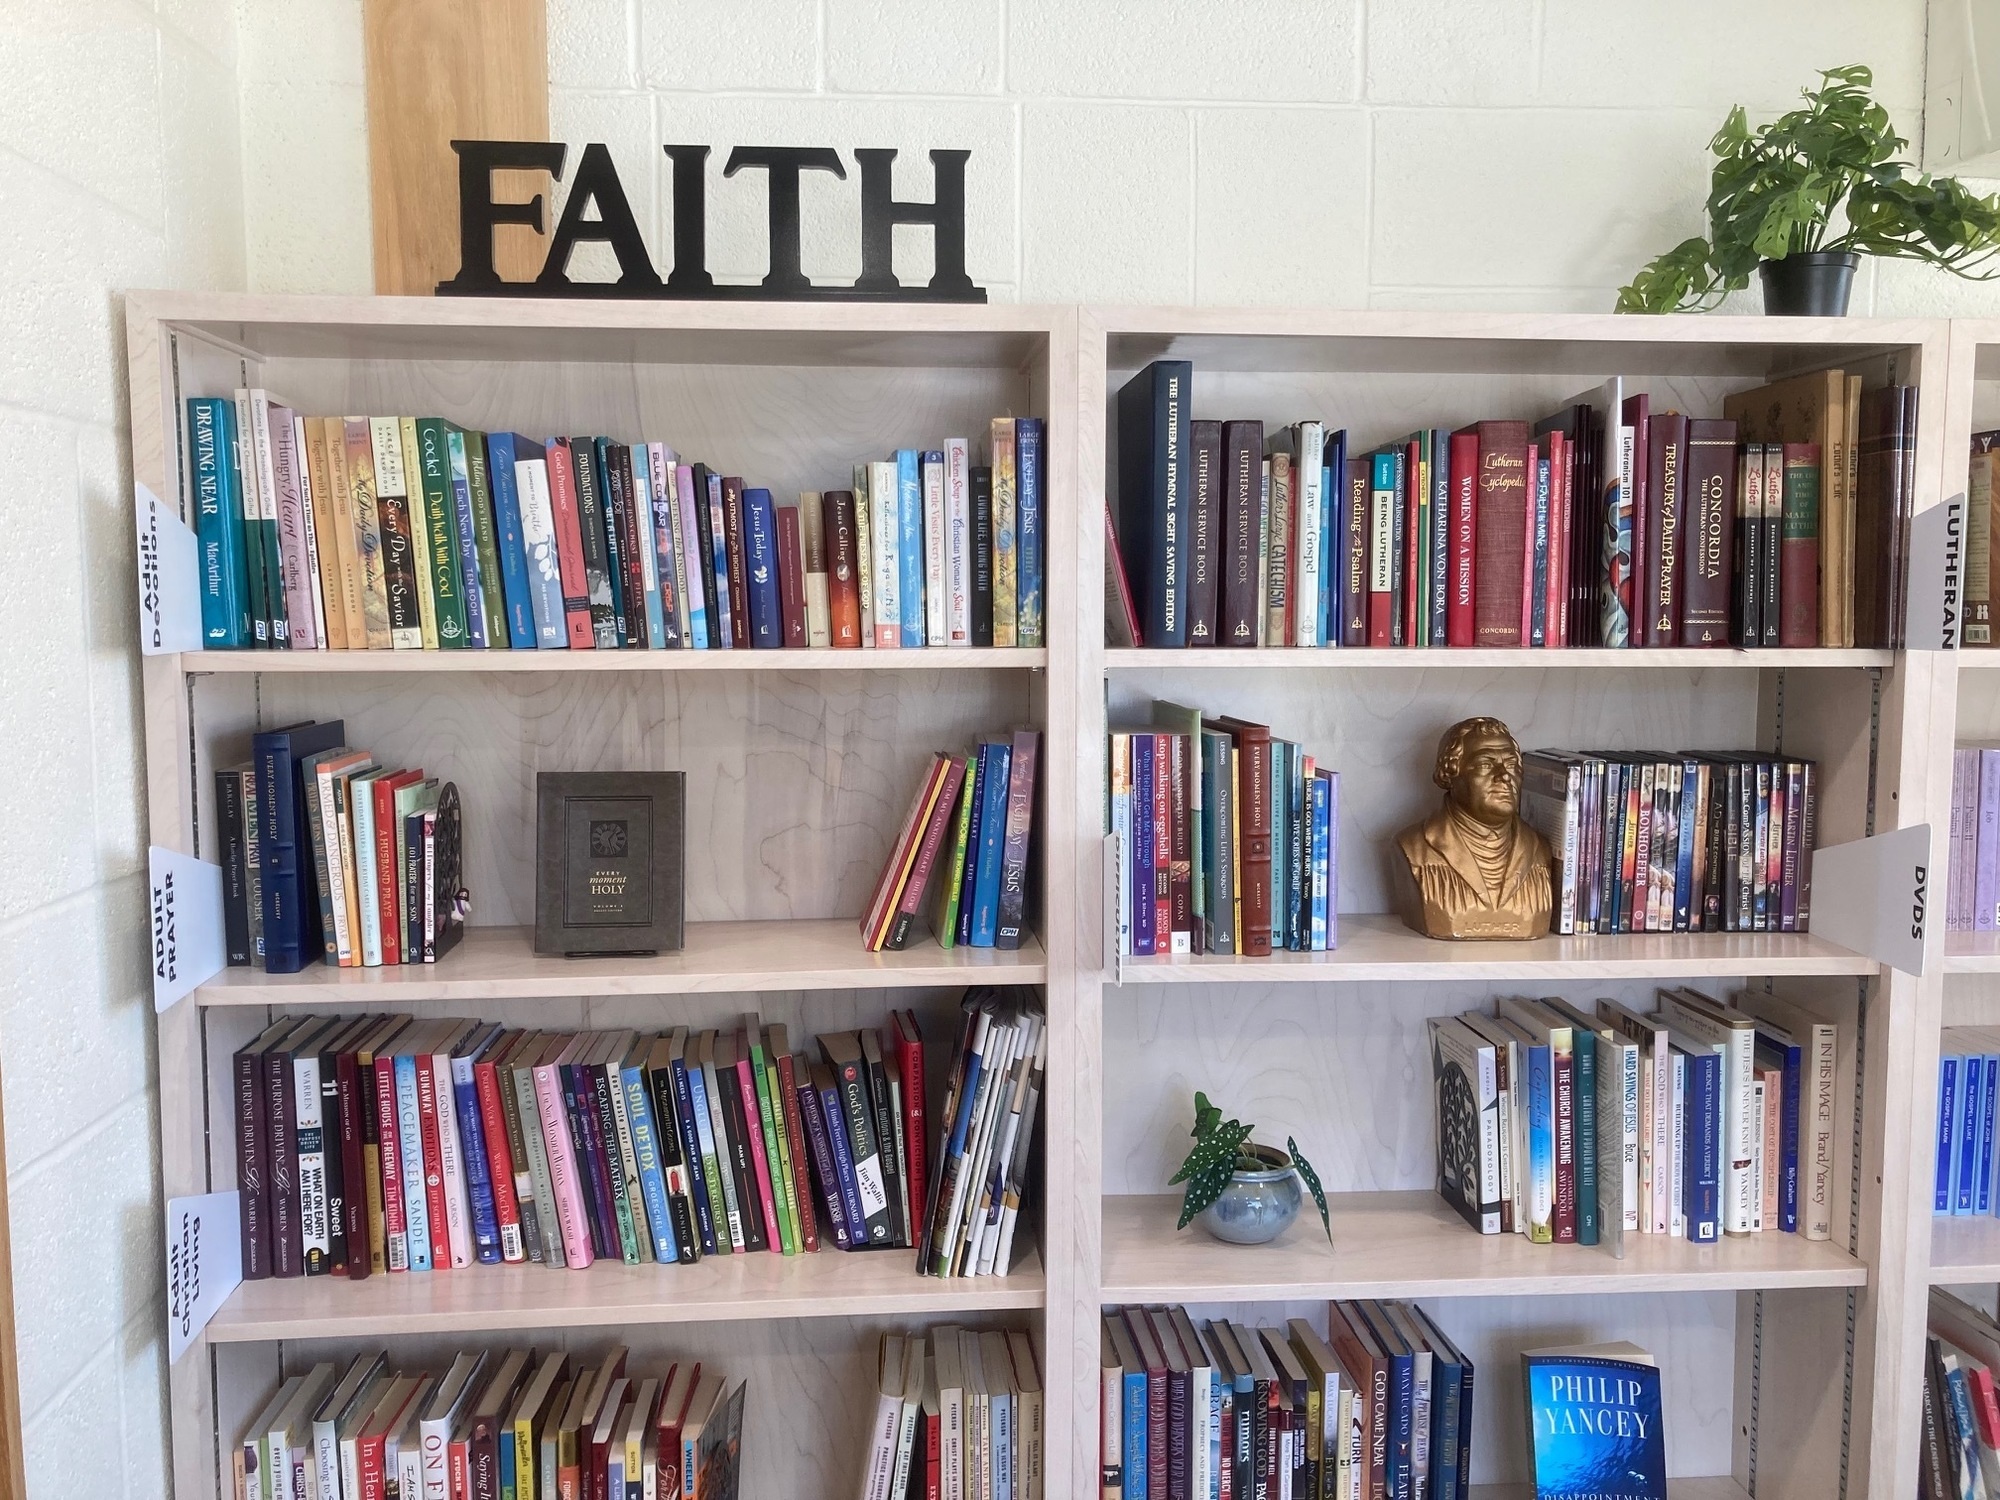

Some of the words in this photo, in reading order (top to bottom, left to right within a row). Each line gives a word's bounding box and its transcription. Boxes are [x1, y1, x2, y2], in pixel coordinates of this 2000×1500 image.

[449, 139, 973, 290] FAITH
[1169, 377, 1178, 398] THE
[196, 405, 216, 470] DRAWING
[1167, 402, 1177, 460] LUTHERAN
[1485, 453, 1523, 470] Lutheran
[1621, 436, 1632, 483] Lutheranism
[1663, 443, 1676, 508] TREASURY
[578, 453, 594, 514] FOUNDATIONS
[1166, 462, 1177, 510] HYMNAL
[1198, 449, 1208, 506] LUTHERAN
[1239, 449, 1249, 506] LUTHERAN
[1621, 486, 1631, 500] 101
[201, 475, 217, 514] NEAR
[456, 488, 467, 511] Each
[1306, 484, 1317, 510] Law
[1460, 476, 1472, 522] WOMEN
[459, 514, 469, 536] New
[1166, 513, 1176, 543] SIGHT
[1306, 514, 1314, 528] and
[1379, 496, 1388, 528] BEING
[1437, 480, 1447, 550] KATHARINA
[1661, 508, 1673, 517] of
[1699, 494, 1708, 529] LUTHERAN
[1707, 475, 1723, 579] CONCORDIA
[1197, 509, 1207, 551] SERVICE
[1238, 509, 1248, 551] SERVICE
[1460, 525, 1470, 543] ON
[1661, 517, 1676, 555] DAILY
[460, 538, 472, 558] Day
[1304, 531, 1317, 574] Gospel
[1378, 531, 1387, 587] LUTHERAN
[1460, 546, 1470, 554] A
[1698, 530, 1707, 575] CONFESSIONS
[141, 532, 152, 613] Adult
[148, 500, 161, 648] Devotions
[206, 541, 221, 596] MacArthur
[465, 567, 474, 585] TEN
[1165, 546, 1175, 586] SAVING
[1196, 554, 1206, 585] BOOK
[1237, 554, 1247, 585] BOOK
[1436, 552, 1446, 579] VON
[1459, 558, 1469, 606] MISSION
[1660, 554, 1673, 606] PRAYER
[1942, 503, 1960, 650] LUTHERAN
[469, 589, 478, 616] BOOM
[1165, 588, 1175, 633] EDITION
[1435, 584, 1446, 615] BORA
[1143, 750, 1151, 777] What
[1157, 739, 1167, 759] stop
[266, 755, 274, 779] EVERY
[1157, 762, 1168, 801] walking
[267, 781, 276, 816] MOMENT
[1141, 779, 1151, 802] Helped
[1142, 805, 1151, 818] Get
[1159, 803, 1166, 814] on
[1985, 810, 1994, 823] Job
[269, 818, 277, 840] HOLY
[1143, 821, 1151, 833] Me
[1157, 815, 1168, 860] eggshells
[1566, 820, 1575, 853] nativity
[1787, 807, 1799, 845] MARTIN
[380, 838, 390, 884] HUSBAND
[1142, 834, 1151, 868] Through
[1636, 810, 1650, 887] BONHOEFFER
[589, 876, 627, 884] moment
[1566, 855, 1574, 878] story
[1785, 850, 1797, 886] LUTHER
[252, 878, 263, 921] COUSER
[382, 888, 392, 918] PRAYS
[591, 885, 625, 895] HOLY
[907, 881, 921, 909] DILLOW
[154, 887, 165, 978] ADULT
[165, 870, 176, 982] PRAYER
[1625, 1050, 1636, 1071] HARD
[1821, 1043, 1832, 1057] IN
[1559, 1068, 1570, 1084] THE
[1820, 1060, 1831, 1079] HIS
[303, 1069, 312, 1110] WARREN
[322, 1079, 338, 1097] 11
[1559, 1085, 1570, 1118] CHURCH
[1625, 1072, 1636, 1101] SAYINGS
[1819, 1082, 1830, 1121] IMAGE
[595, 1078, 612, 1130] ESCAPING
[846, 1083, 861, 1116] God's
[854, 1117, 869, 1156] Politics
[1625, 1103, 1636, 1113] OF
[627, 1083, 642, 1121] SOUL
[636, 1126, 655, 1172] DETOX
[1623, 1113, 1636, 1134] JESUS
[605, 1133, 616, 1155] THE
[1486, 1119, 1494, 1194] PARADOXOLOGY
[1560, 1119, 1571, 1164] AWAKENING
[1624, 1144, 1635, 1163] Bruce
[301, 1169, 312, 1184] AM
[312, 1168, 322, 1194] WHAT
[609, 1157, 624, 1200] MATRIX
[858, 1167, 871, 1180] Jim
[865, 1181, 885, 1205] Wallis
[1740, 1173, 1748, 1210] YANCEY
[302, 1191, 313, 1213] HERE
[314, 1196, 323, 1210] ON
[648, 1181, 662, 1231] GROESCHEL
[846, 1188, 859, 1224] HURNARD
[1558, 1170, 1568, 1218] SWINDOLL
[248, 1199, 257, 1232] WARREN
[279, 1198, 287, 1231] WARREN
[303, 1214, 314, 1236] FOR?
[314, 1212, 324, 1240] EARTH
[330, 1197, 342, 1237] Sweet
[410, 1199, 424, 1245] SANDE
[677, 1202, 688, 1241] MANNING
[1624, 1210, 1635, 1221] IVP
[192, 1215, 201, 1301] Living
[171, 1242, 180, 1318] Adult
[181, 1213, 191, 1338] Christian
[1374, 1371, 1386, 1401] GOD
[1401, 1367, 1410, 1391] MAX
[1550, 1375, 1642, 1407] PHILIP
[885, 1412, 894, 1440] PETERSON
[905, 1416, 914, 1443] PETERSON
[1257, 1381, 1267, 1446] KNOWING
[1374, 1403, 1384, 1433] CAME
[1401, 1392, 1409, 1435] LUCADO
[1545, 1408, 1649, 1439] YANCEY
[425, 1435, 443, 1470] ON
[1237, 1410, 1250, 1463] rumors
[1352, 1435, 1361, 1464] TURN
[1374, 1434, 1385, 1467] NEAR
[319, 1438, 332, 1482] Choosing
[1222, 1457, 1231, 1469] NO
[1257, 1448, 1267, 1478] GOD
[323, 1484, 332, 1494] to
[1221, 1470, 1231, 1492] MERCY
